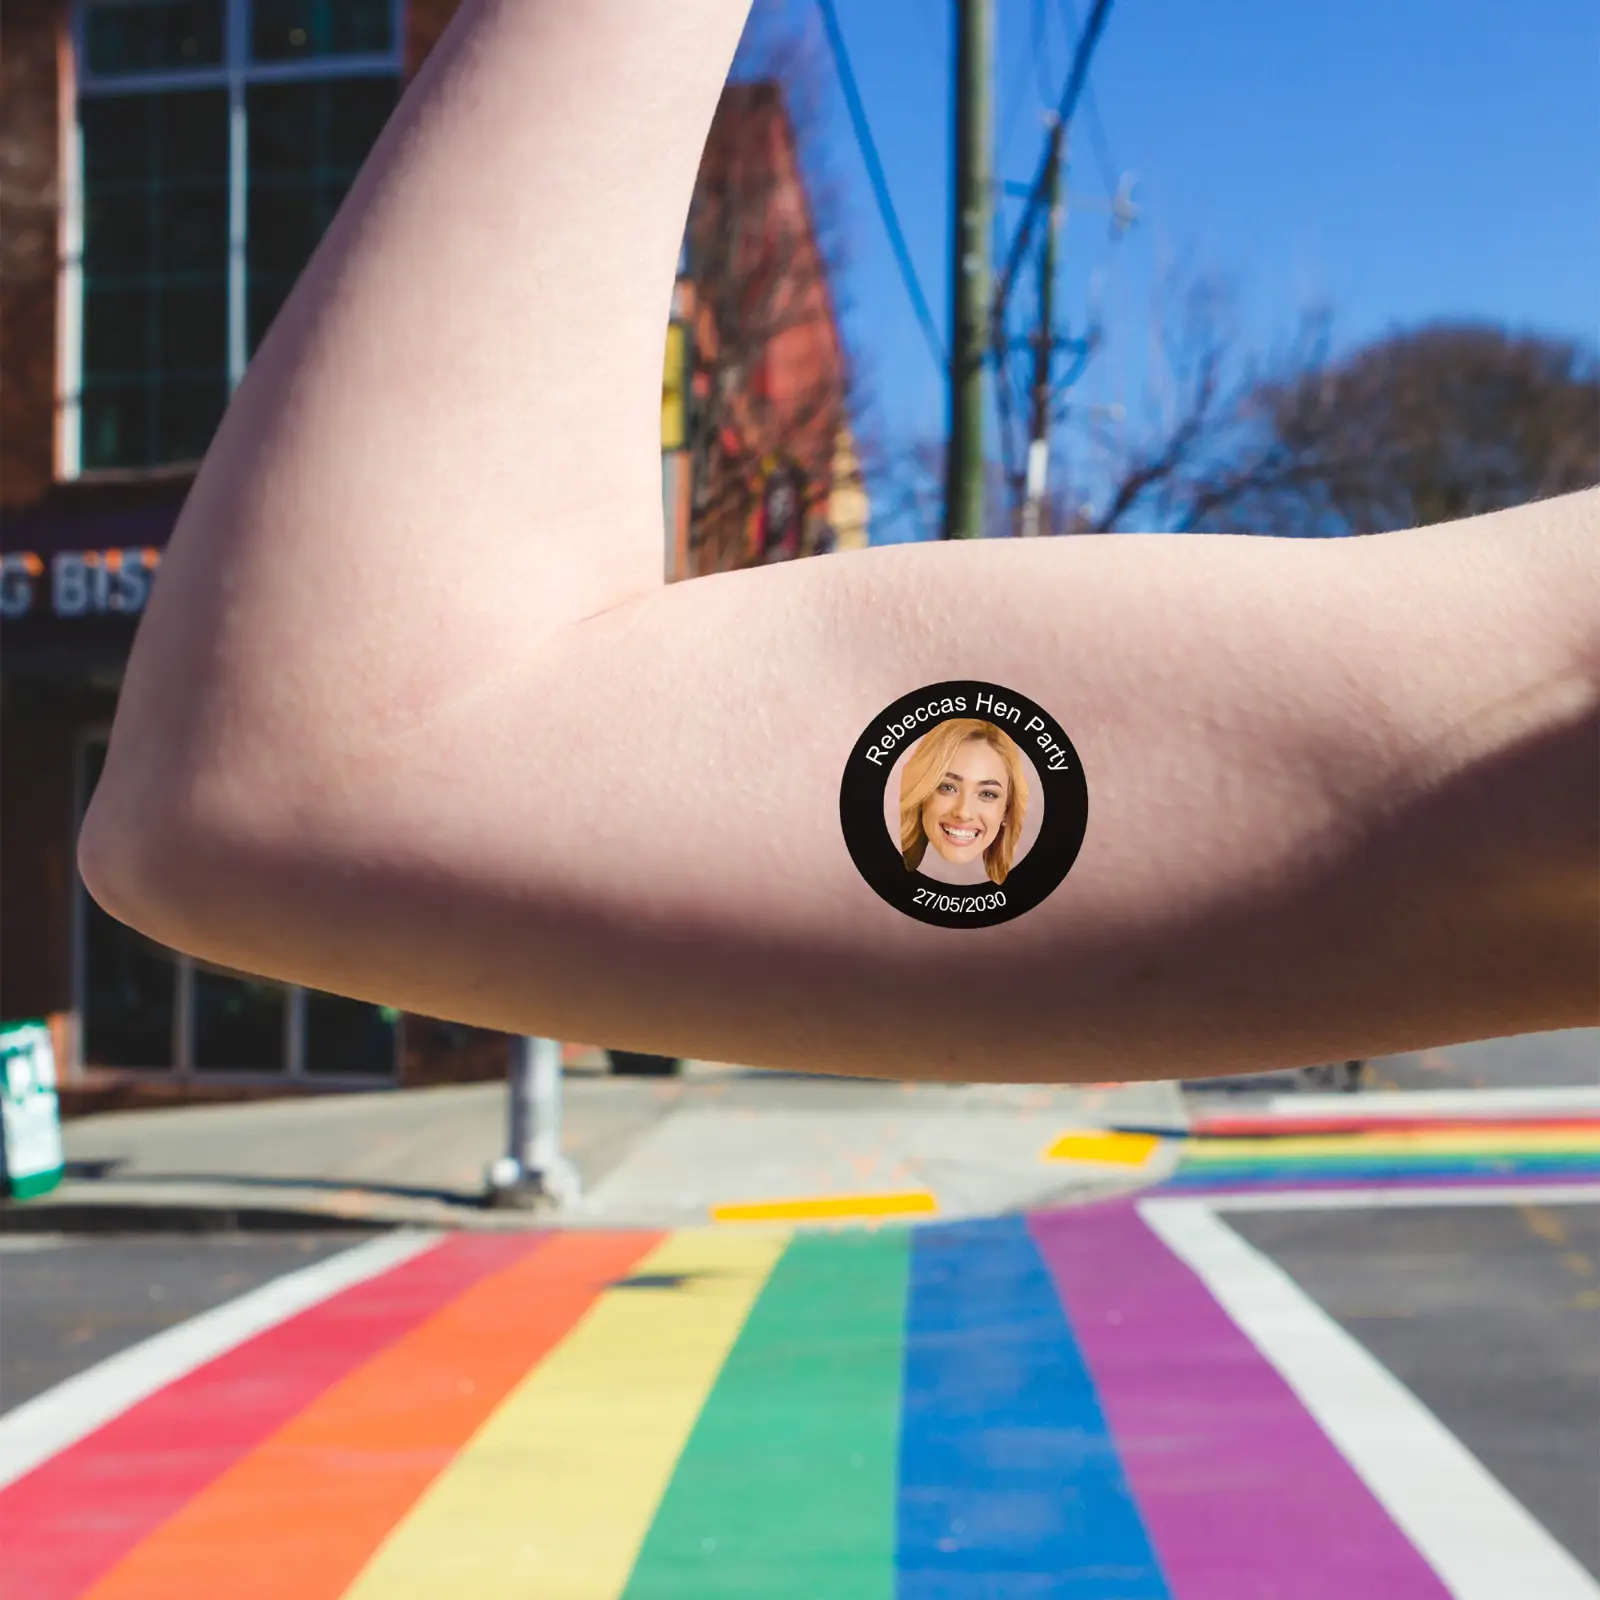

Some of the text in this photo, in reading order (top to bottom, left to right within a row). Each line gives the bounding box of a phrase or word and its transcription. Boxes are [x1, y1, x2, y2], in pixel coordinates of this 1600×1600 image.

[865, 692, 1069, 772] Rebeccas Hen Party
[912, 888, 1007, 913] 27/05/2030
